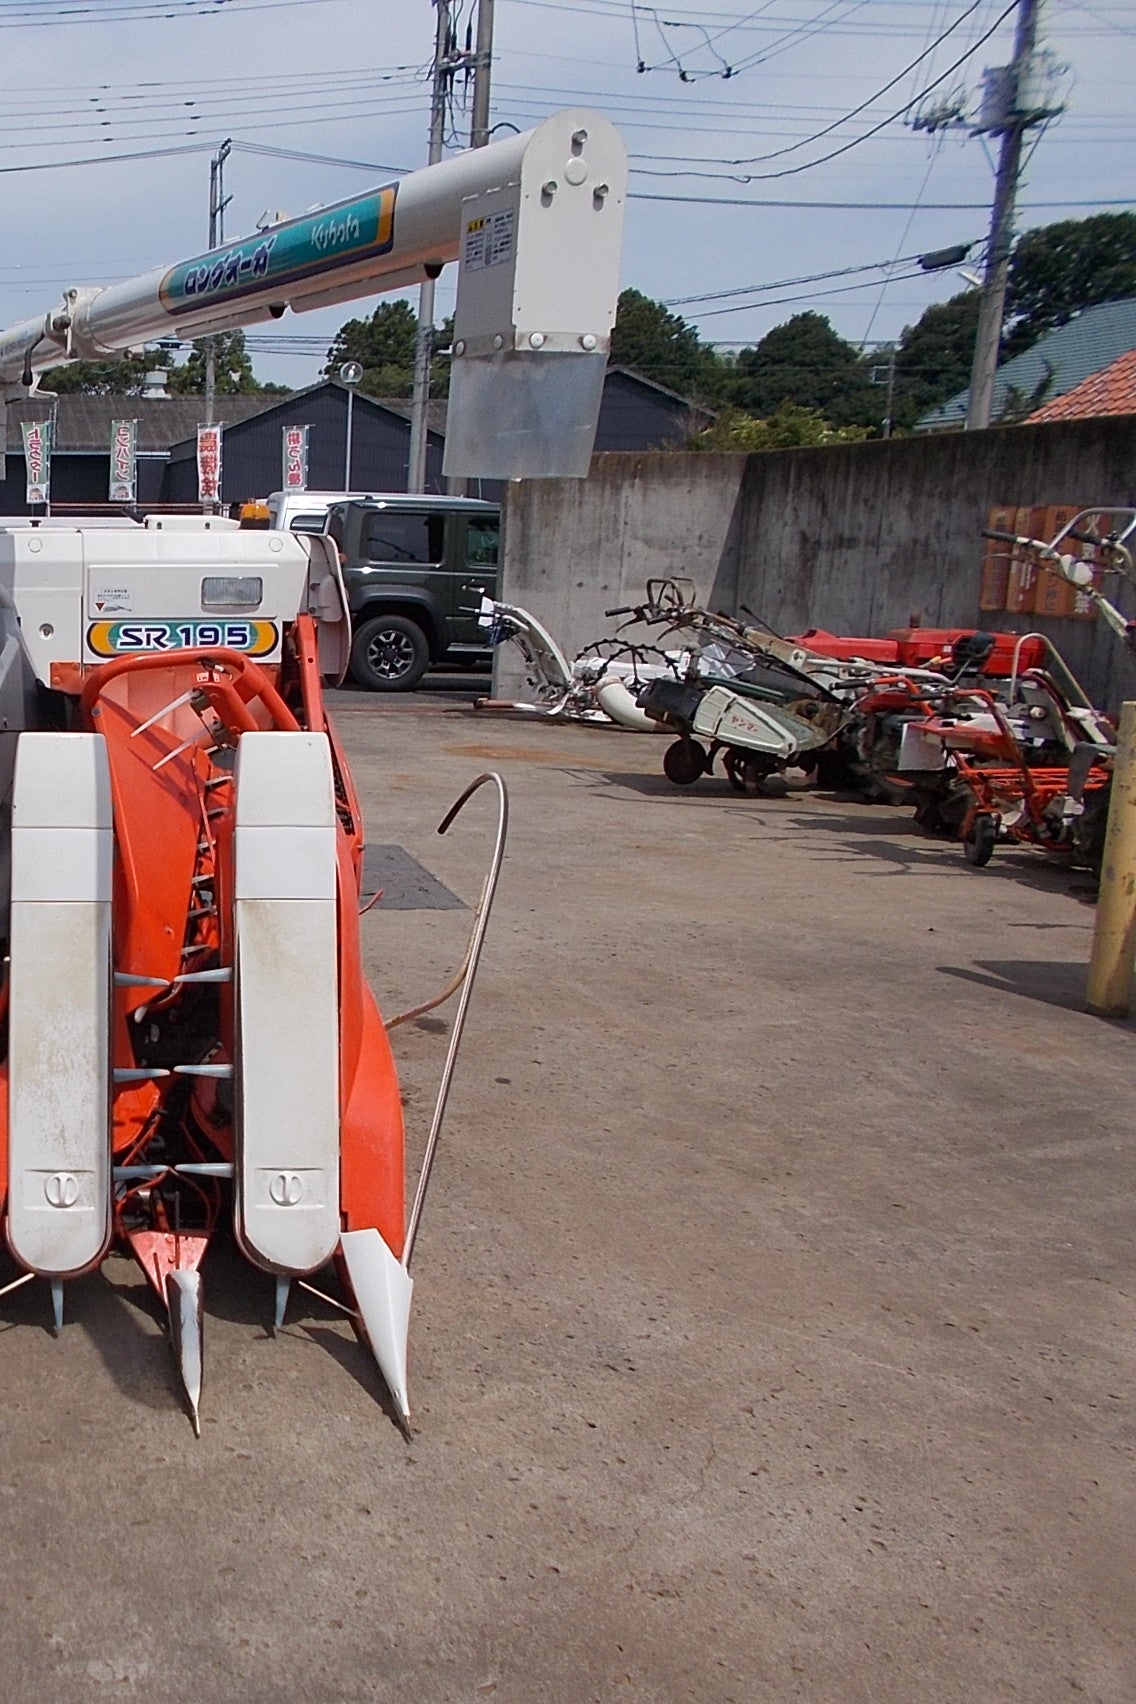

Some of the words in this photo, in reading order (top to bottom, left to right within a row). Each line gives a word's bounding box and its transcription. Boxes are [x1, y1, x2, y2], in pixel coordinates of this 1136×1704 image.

[311, 214, 360, 250] Kubota
[184, 235, 277, 296] ロングオーガ
